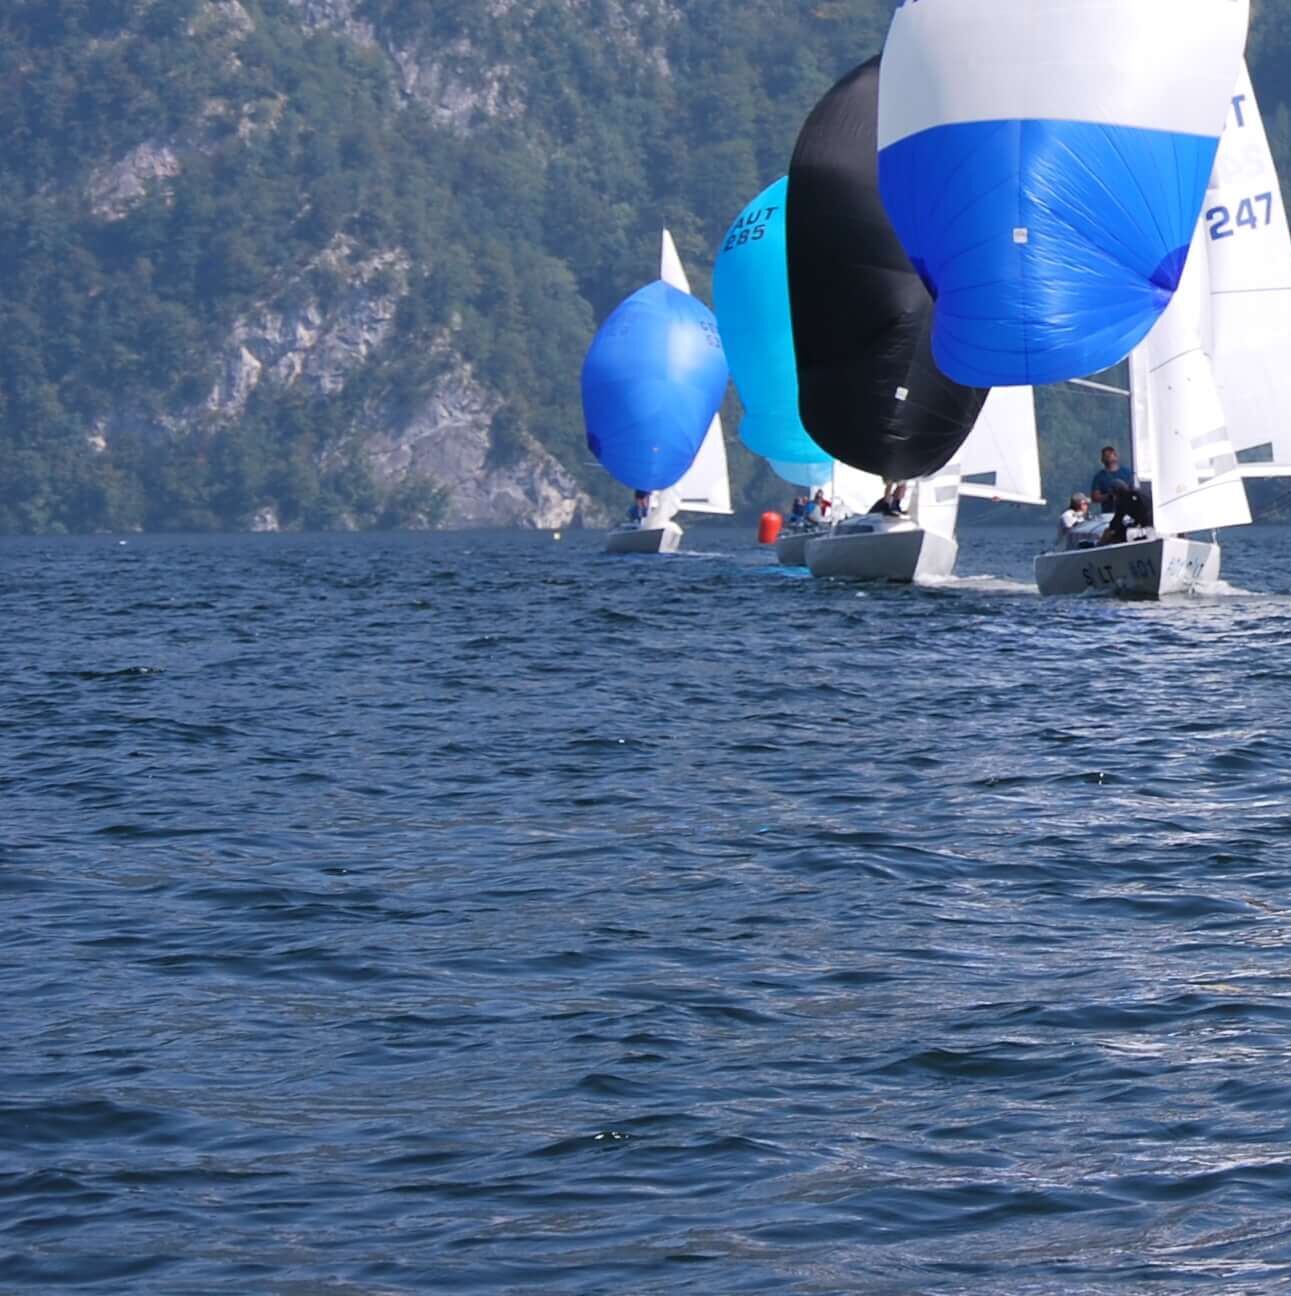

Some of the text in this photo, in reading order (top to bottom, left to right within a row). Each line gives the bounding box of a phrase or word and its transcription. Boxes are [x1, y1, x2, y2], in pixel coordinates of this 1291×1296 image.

[736, 206, 779, 229] AUT
[1206, 192, 1273, 241] 247
[724, 224, 766, 252] 285
